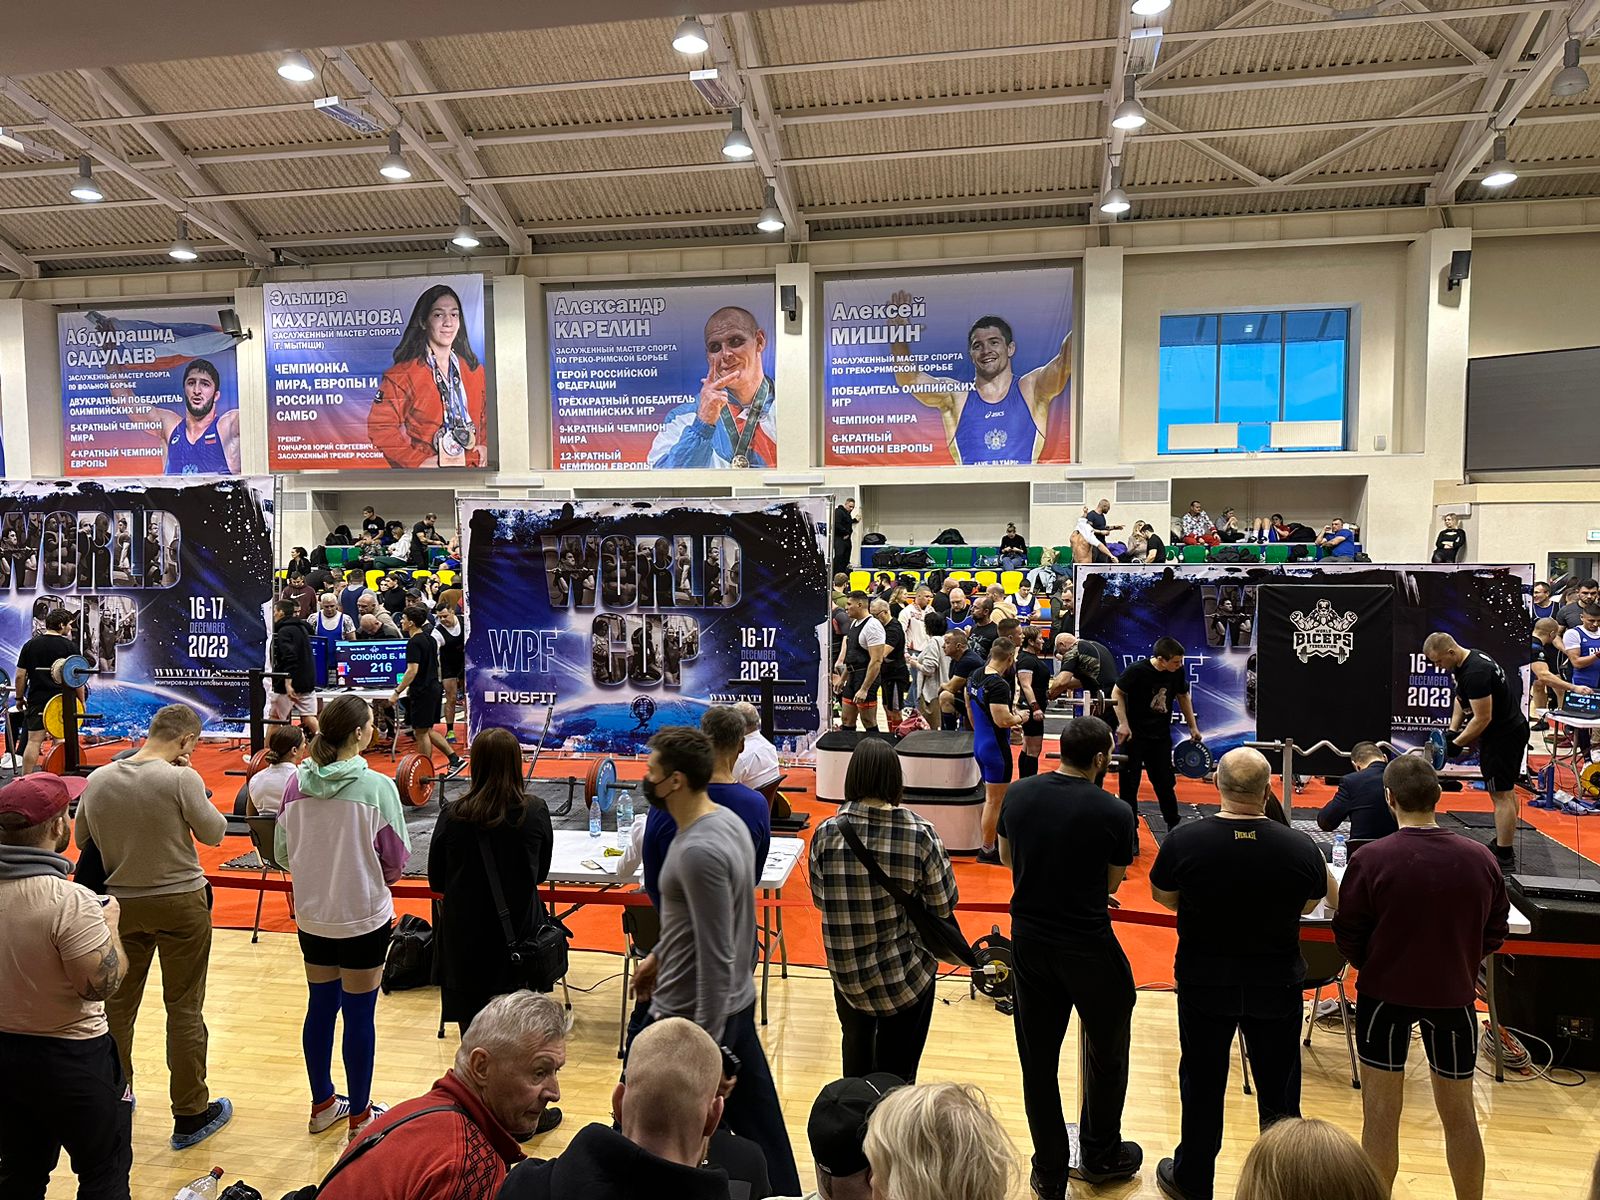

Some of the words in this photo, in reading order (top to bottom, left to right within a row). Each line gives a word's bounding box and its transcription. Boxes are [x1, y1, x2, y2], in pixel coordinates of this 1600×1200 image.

[270, 290, 348, 308] Эльмира
[554, 296, 666, 315] Александр
[832, 297, 927, 321] Алексей
[272, 309, 404, 329] КАХРАМАНОВА
[272, 330, 335, 340] ЗАСЛУЖЕННЫЙ
[336, 329, 368, 338] МАСТЕР
[369, 328, 401, 337] СПОРТА
[554, 319, 651, 339] КАРЕЛИН
[831, 324, 921, 346] МИШИН
[66, 328, 175, 346] Абдулрашид
[555, 345, 615, 355] ЗАСЛУЖЕННЫЙ
[616, 345, 646, 353] МАСТЕР
[647, 344, 677, 353] СПОРТА
[66, 348, 157, 368] САДУЛАЕВ
[555, 356, 568, 364] ПО
[569, 354, 636, 364] ГРЕКО-РИМСКОЙ
[636, 353, 669, 362] БОРЬБЕ
[831, 354, 895, 365] ЗАСЛУЖЕННЫЙ
[896, 354, 930, 363] МАСТЕР
[931, 353, 963, 362] СПОРТА
[275, 362, 349, 375] ЧЕМПИОНКА
[556, 368, 588, 380] ГЕРОЙ
[590, 368, 658, 378] РОССИЙСКОЙ
[831, 366, 844, 375] ПО
[845, 364, 917, 374] ГРЕКО-РИМСКОЙ
[918, 363, 953, 372] БОРЬБЕ
[68, 373, 117, 382] ЗАСЛУЖЕННЫЙ
[78, 382, 109, 390] ВОЛЬНОЙ
[275, 378, 312, 392] МИРА,
[314, 377, 367, 390] ЕВРОПЫ
[369, 377, 378, 389] И
[556, 380, 617, 391] ФЕДЕРАЦИИ
[831, 385, 900, 397] ПОБЕДИТЕЛЬ
[69, 396, 127, 407] ДВУКРАТНЫЙ
[128, 395, 183, 405] ПОБЕДИТЕЛЬ
[276, 394, 324, 406] РОССИИ
[326, 394, 344, 405] ПО
[558, 396, 629, 406] ТРЁХКРАТНЫЙ
[631, 395, 696, 405] ПОБЕДИТЕЛЬ
[831, 398, 852, 407] ИГР
[69, 407, 134, 416] ОЛИМПИЙСКИХ
[135, 406, 152, 414] ИГР
[276, 410, 318, 422] САМБО
[558, 406, 635, 416] ОЛИМПИЙСКИХ
[636, 407, 655, 416] ИГР
[831, 415, 885, 425] ЧЕМПИОН
[887, 415, 918, 424] МИРА
[70, 421, 117, 432] 5-КРАТНЫЙ
[119, 421, 162, 430] ЧЕМПИОН
[559, 423, 615, 433] 9-КРАТНЫЙ
[617, 423, 666, 432] ЧЕМПИОН
[70, 434, 94, 442] МИРА
[559, 435, 587, 444] МИРА
[831, 431, 893, 443] 6-КРАТНЫЙ
[70, 447, 119, 458] 4-КРАТНЫЙ
[121, 448, 163, 457] ЧЕМПИОН
[831, 444, 885, 454] ЧЕМПИОН
[887, 443, 933, 453] ЕВРОПЫ
[560, 450, 621, 461] 12-КРАТНЫЙ
[70, 459, 108, 468] ЕВРОПЫ
[560, 462, 608, 471] ЧЕМПИОН
[0, 510, 182, 589] WORLD
[540, 534, 743, 610] WORLD
[189, 597, 224, 620] 16-17
[189, 621, 226, 634] DECEMBER
[740, 627, 776, 648] 16-17
[1294, 632, 1352, 647] BICEPS
[188, 635, 229, 659] 2023
[488, 629, 558, 673] WPF
[591, 613, 701, 688] CUP
[350, 653, 388, 661] СОЮНОВ
[740, 650, 776, 661] DECEMBER
[370, 662, 392, 673] 216
[740, 661, 779, 681] 2023
[1409, 675, 1449, 687] DECEMBER
[498, 691, 557, 704] RUSFIT
[1407, 687, 1451, 708] 2023
